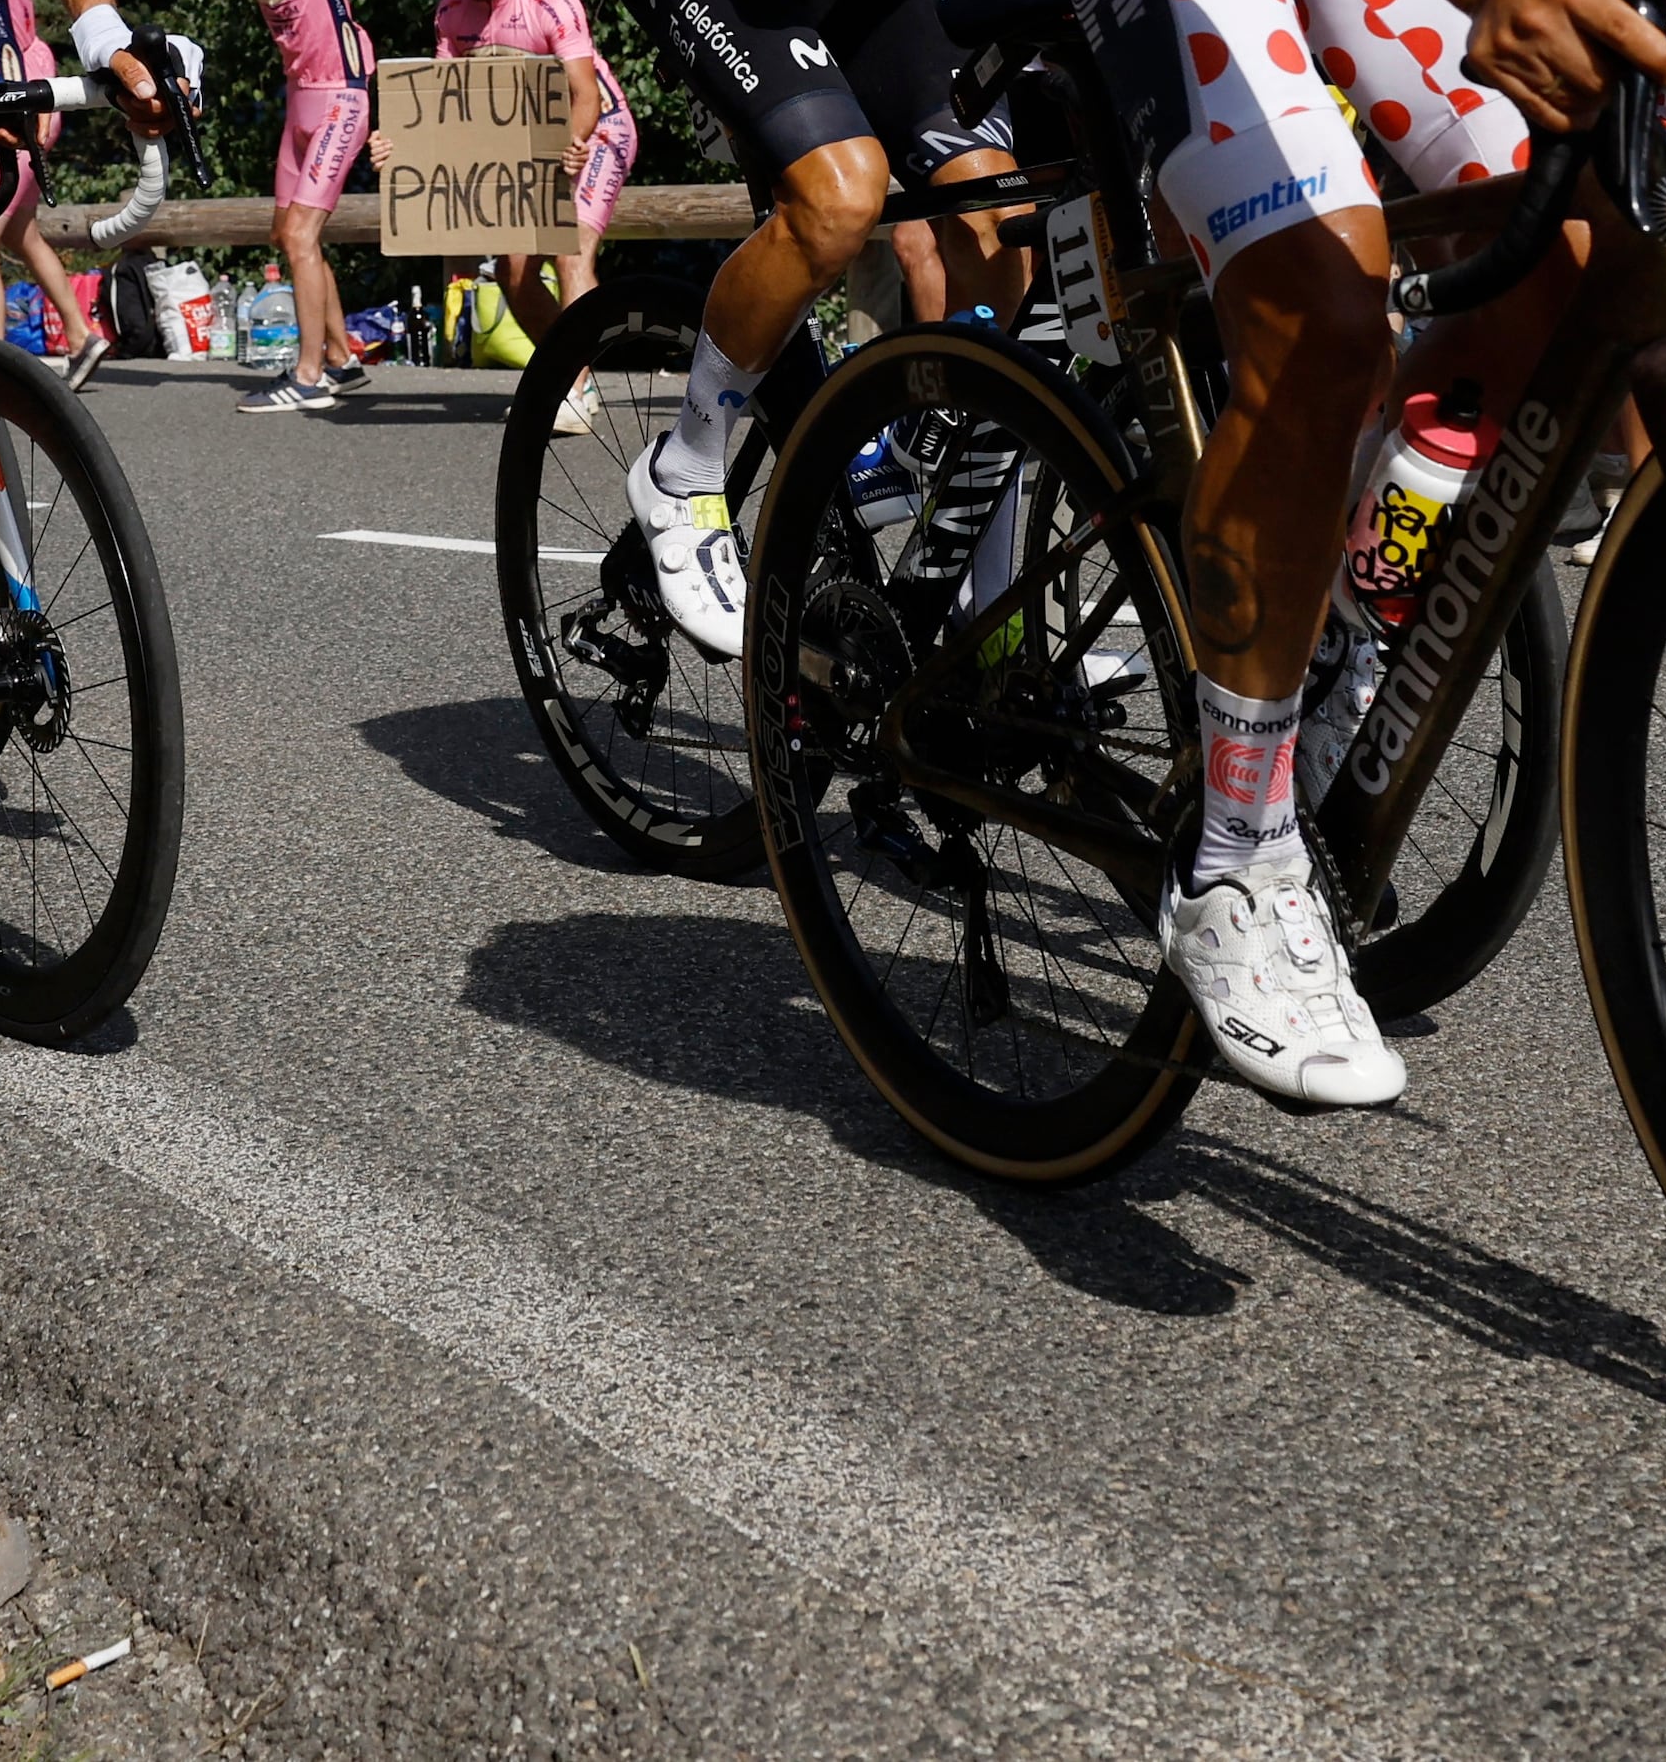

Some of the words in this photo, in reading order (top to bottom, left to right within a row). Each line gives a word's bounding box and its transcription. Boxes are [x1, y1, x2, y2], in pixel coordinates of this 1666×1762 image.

[668, 13, 697, 68] Tech
[387, 59, 473, 130] J'AI
[487, 62, 568, 127] UNE
[308, 121, 337, 185] Mercatone
[326, 108, 362, 183] ALBACOM
[579, 143, 609, 207] Mercatone
[601, 132, 631, 206] ALBACOM
[389, 156, 579, 237] PANCARTE
[995, 174, 1029, 190] AEROAD
[1207, 165, 1328, 245] Santini
[1052, 226, 1102, 331] 111
[1124, 289, 1181, 438] LAB71
[861, 482, 903, 501] GARMIN
[1350, 399, 1561, 796] cannondale
[1201, 697, 1302, 736] cannond
[1217, 1015, 1287, 1060] SIDI
